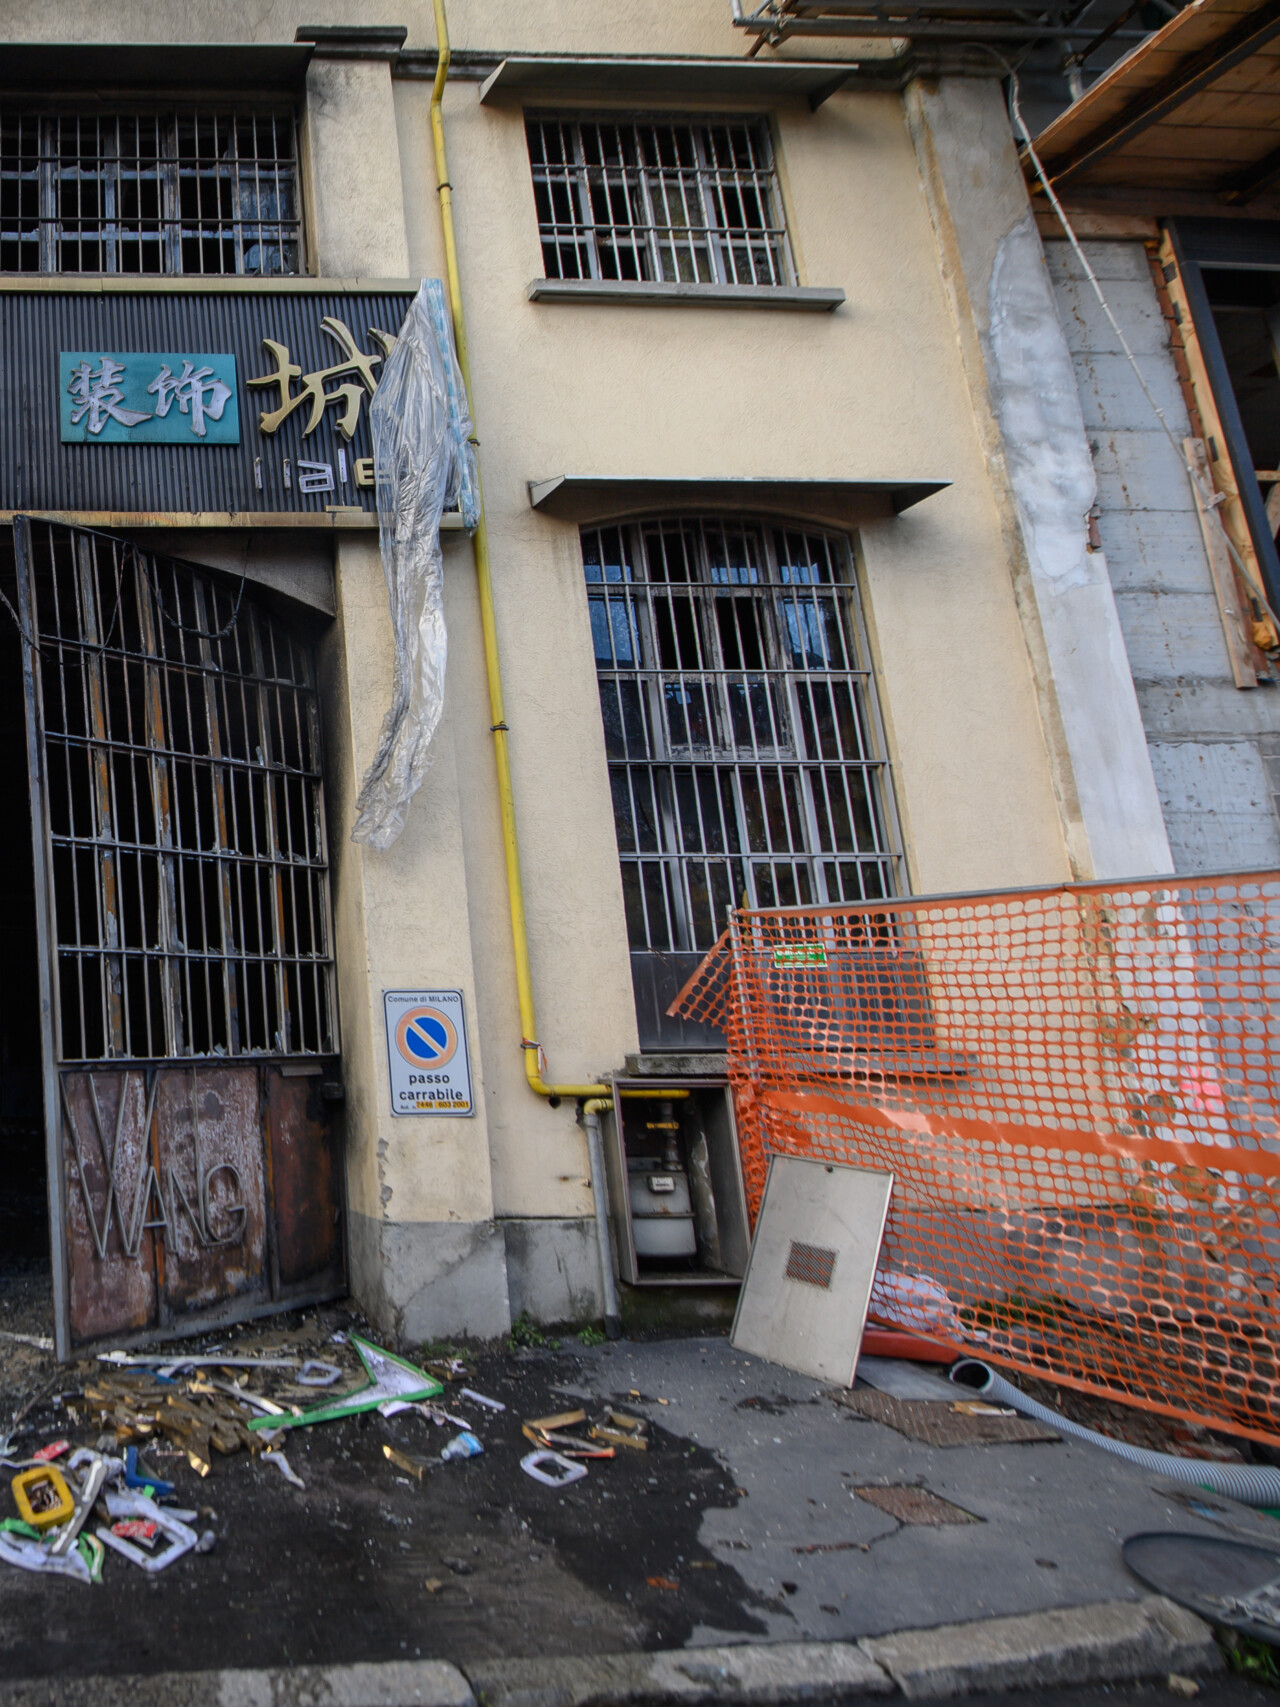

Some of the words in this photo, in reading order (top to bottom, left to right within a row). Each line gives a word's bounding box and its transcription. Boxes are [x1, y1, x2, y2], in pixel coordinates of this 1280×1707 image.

[409, 1074, 450, 1085] passo
[399, 1089, 463, 1100] carrabile
[59, 1065, 247, 1260] WANG
